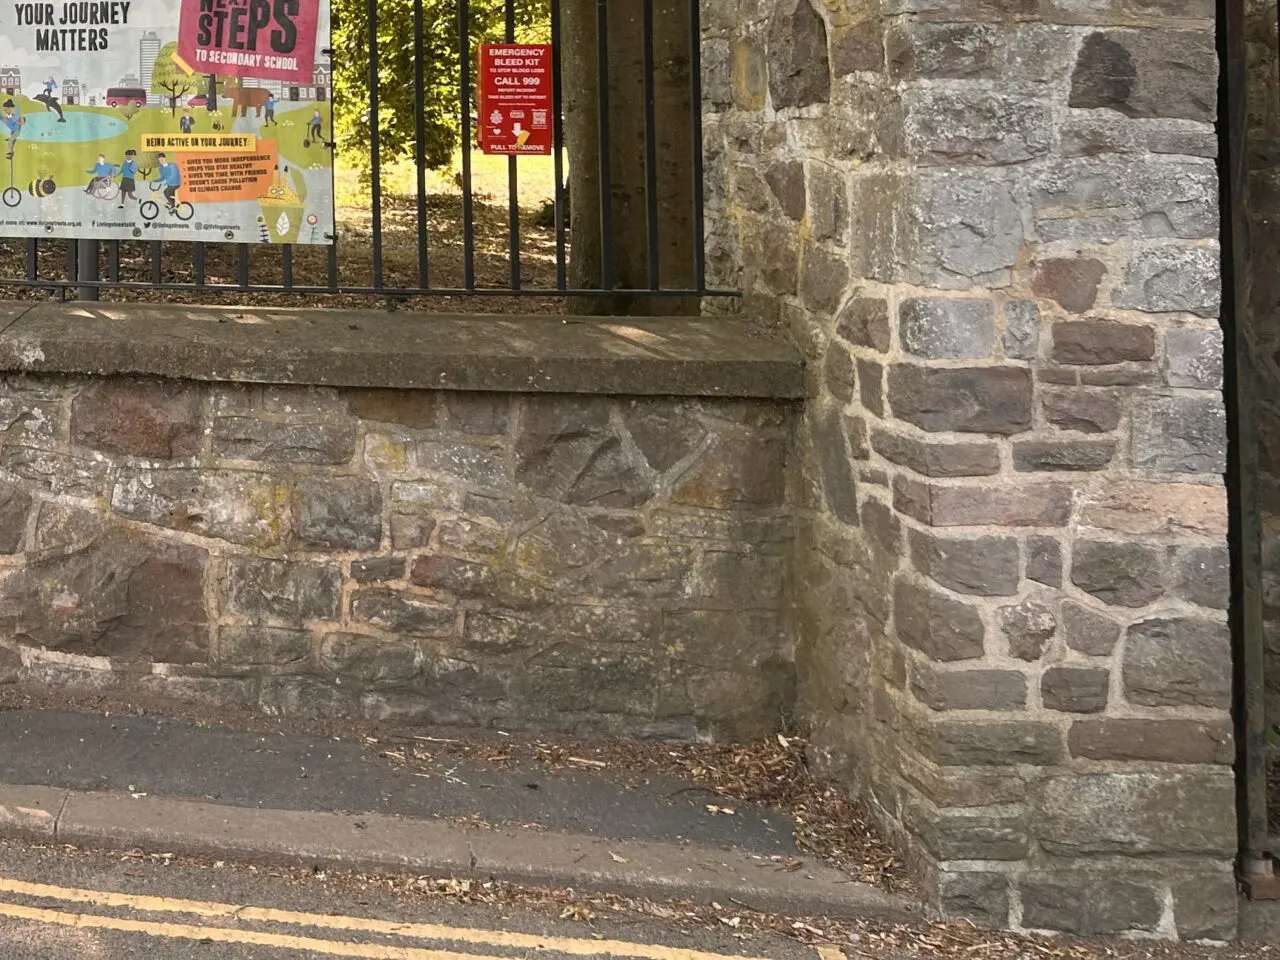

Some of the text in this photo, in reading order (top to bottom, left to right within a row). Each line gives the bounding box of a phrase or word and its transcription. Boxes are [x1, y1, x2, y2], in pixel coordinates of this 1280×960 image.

[14, 1, 131, 26] YOUR JOURNEY
[36, 28, 109, 51] MATTERS
[489, 48, 545, 56] EMERGENCY
[195, 49, 299, 71] TO SECONDARY SCHOOL
[494, 58, 540, 66] BLEED KIT
[494, 76, 541, 86] CALL 999
[146, 138, 165, 147] BEING
[167, 138, 189, 147] ACTIVE
[200, 137, 217, 147] YOUR
